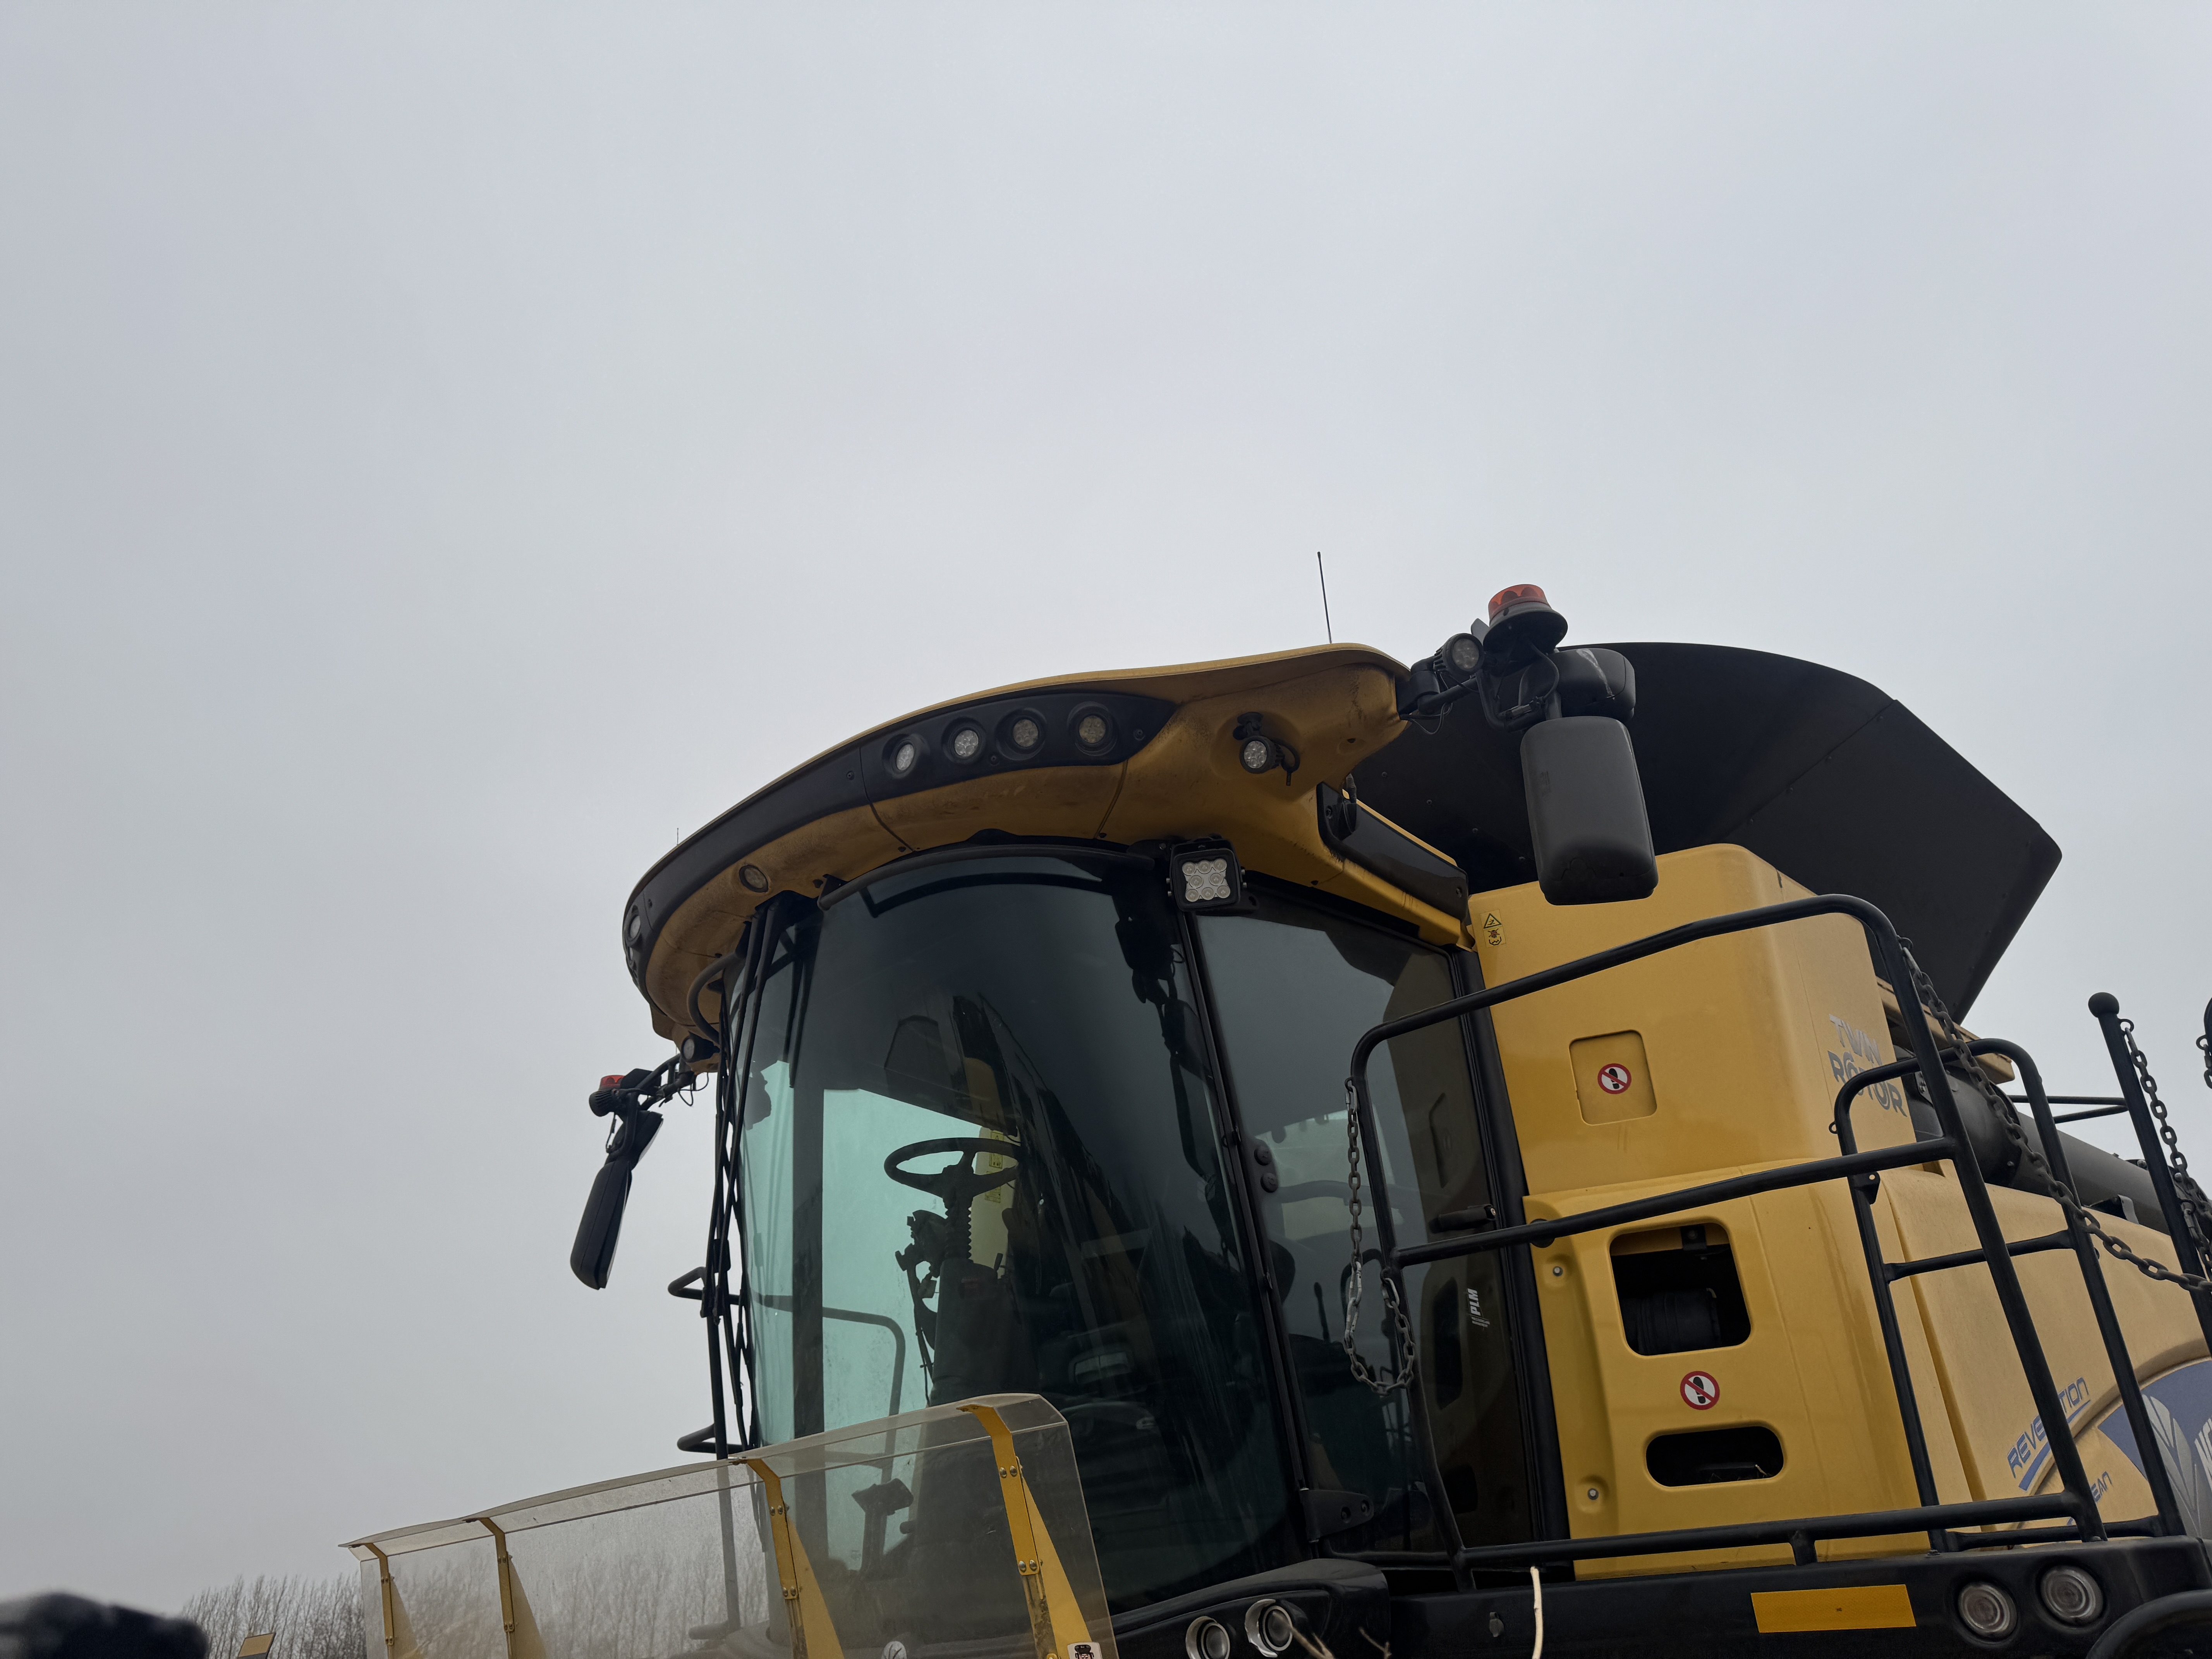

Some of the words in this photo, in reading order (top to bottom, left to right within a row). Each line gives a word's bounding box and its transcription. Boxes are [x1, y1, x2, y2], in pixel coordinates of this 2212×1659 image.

[1829, 1013, 1883, 1066] TWIN
[1467, 1288, 1481, 1316] PLM
[2007, 1376, 2089, 1479] REVETION
